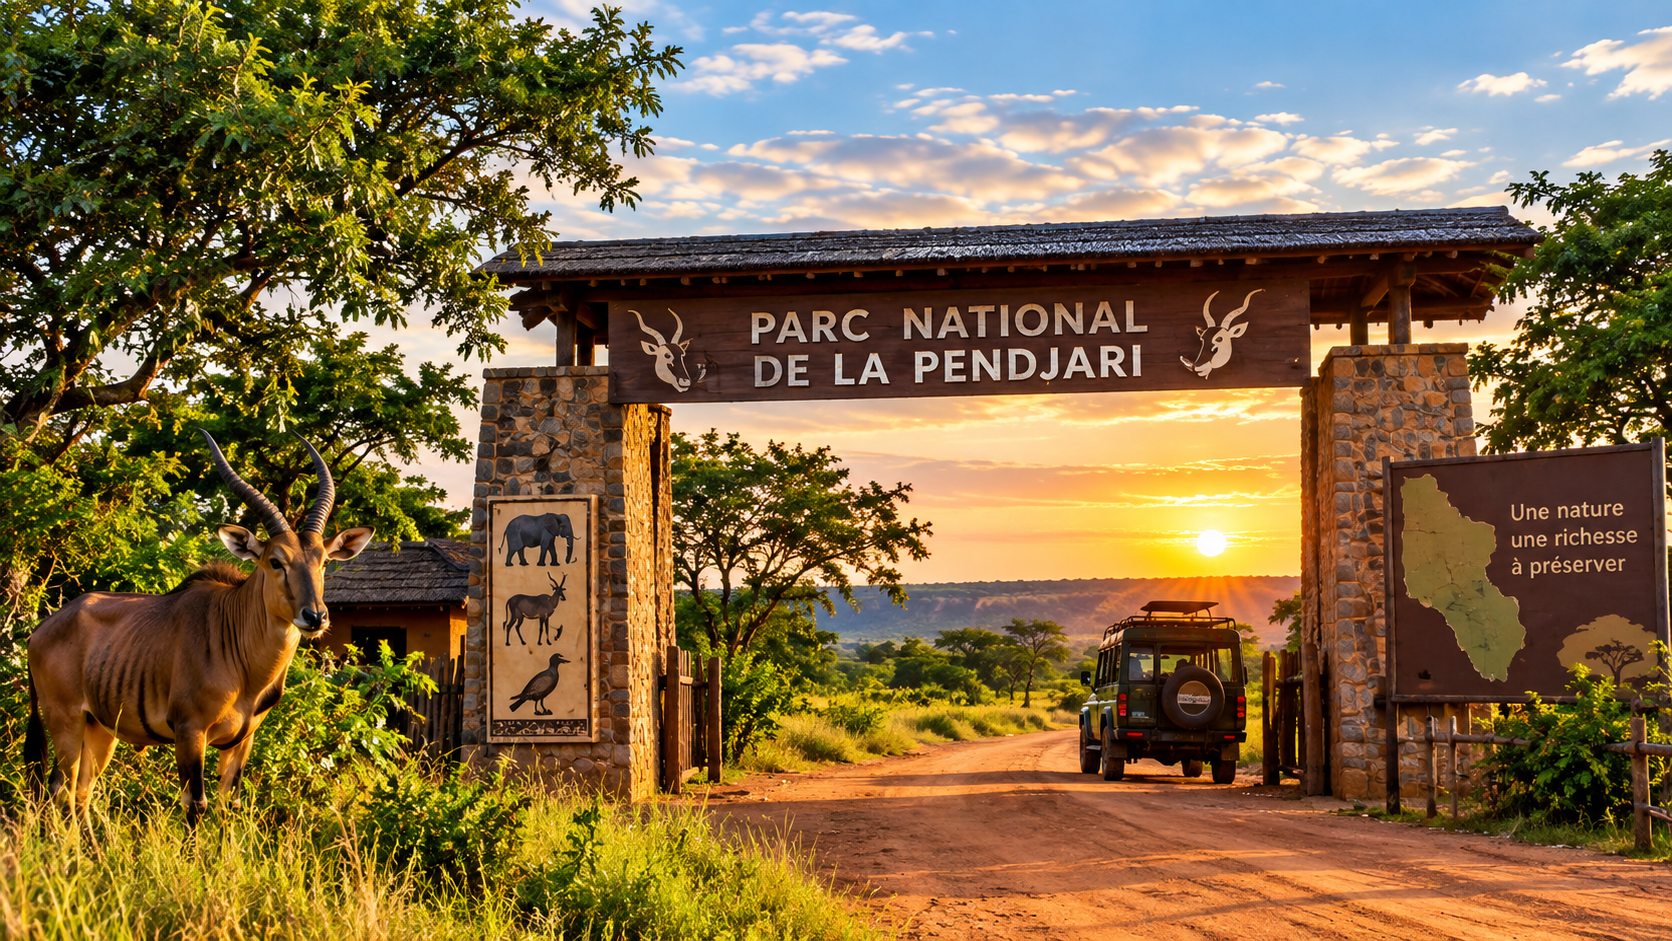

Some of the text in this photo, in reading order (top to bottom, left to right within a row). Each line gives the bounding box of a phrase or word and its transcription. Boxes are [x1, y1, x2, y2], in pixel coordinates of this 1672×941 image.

[752, 301, 1147, 344] PARC NATIONAL
[755, 345, 1141, 387] DE LA PENDJARI
[1511, 502, 1623, 521] Une nature
[1512, 528, 1637, 548] une richesse
[1512, 556, 1625, 578] à préserver
